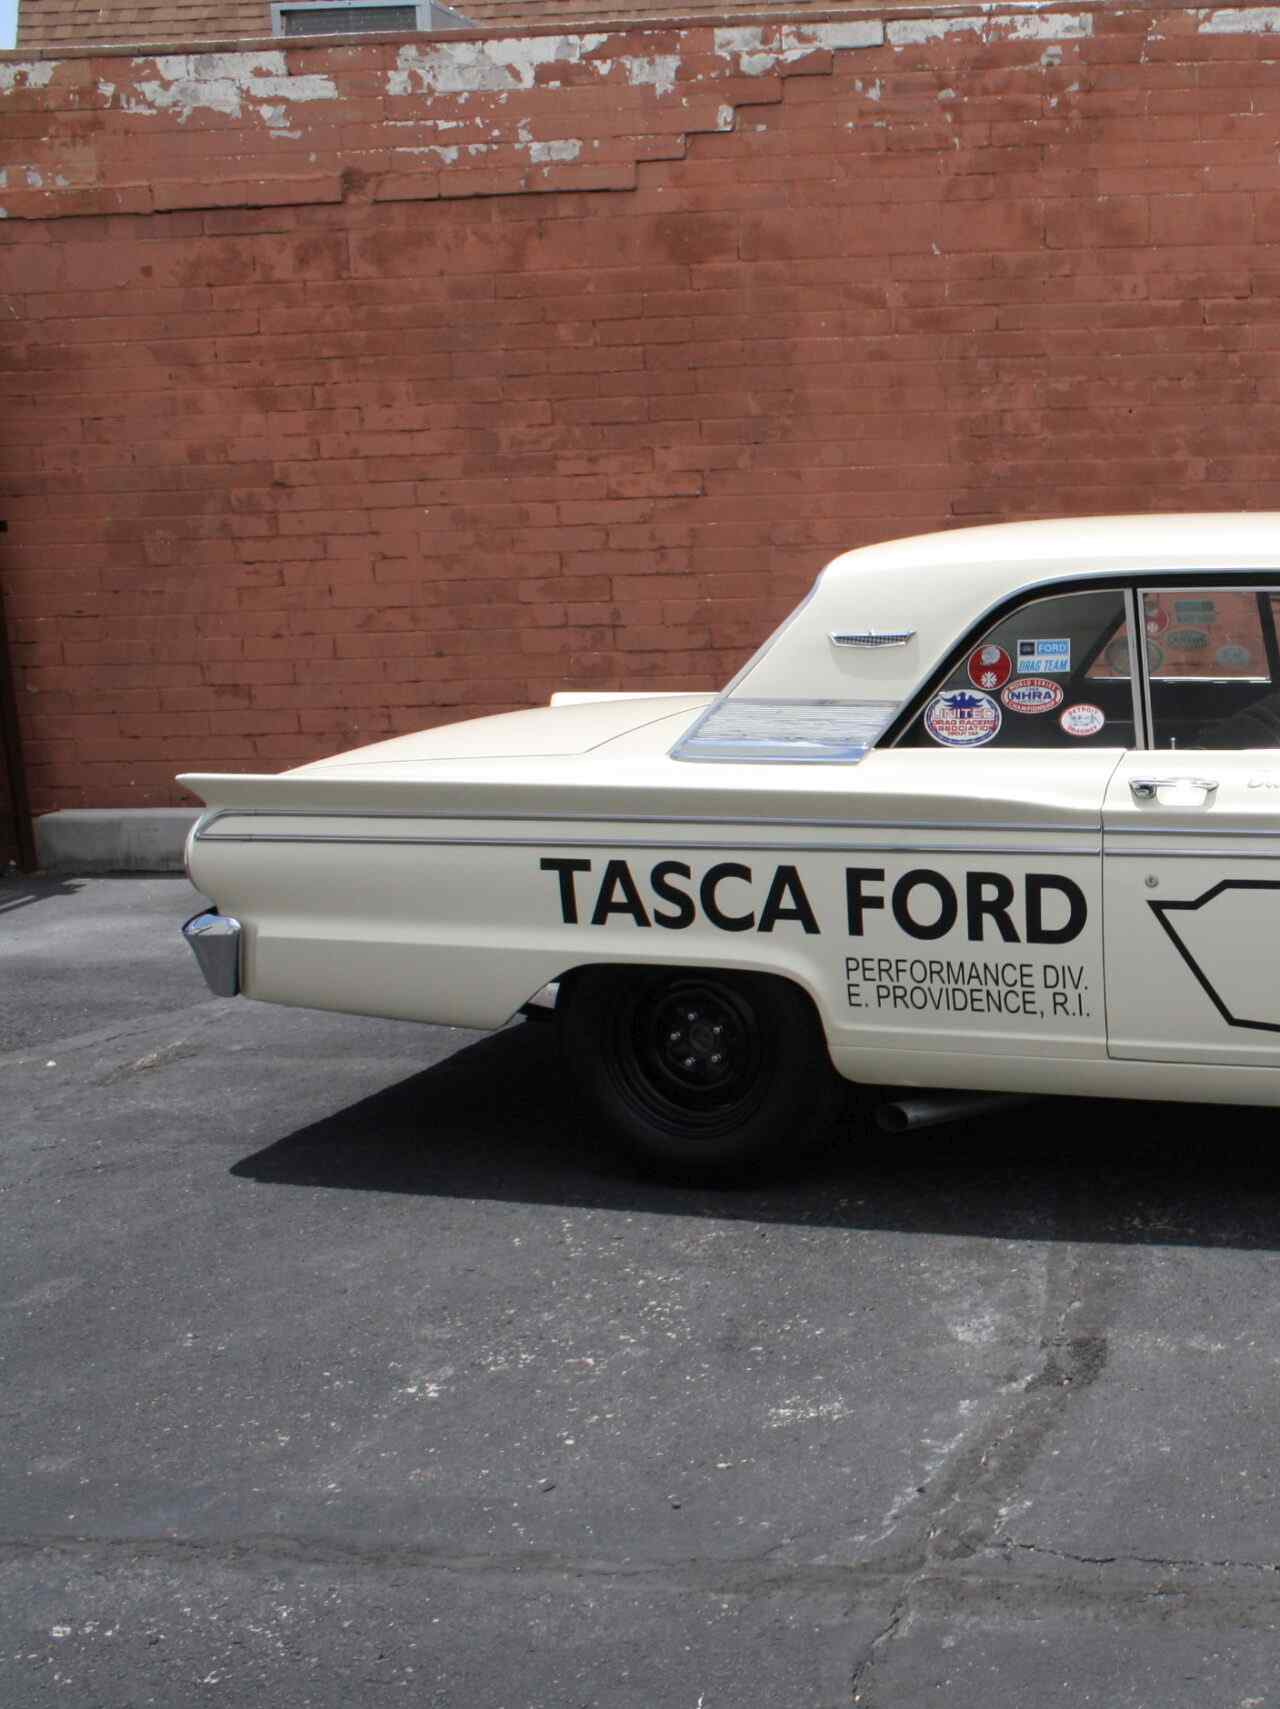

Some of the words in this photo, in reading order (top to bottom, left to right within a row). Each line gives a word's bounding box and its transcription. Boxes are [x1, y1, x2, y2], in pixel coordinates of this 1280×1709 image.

[1038, 643, 1067, 653] FORD
[1043, 659, 1068, 671] TEAM
[1010, 691, 1053, 700] NHRA
[932, 707, 994, 719] UNITED
[540, 857, 821, 935] TASCA
[845, 867, 1088, 945] FORD
[845, 957, 1035, 988] PERFORMANCE
[1043, 964, 1089, 990] DIV.
[847, 983, 869, 1007] E.
[876, 984, 1045, 1018] PROVIDENCE,
[1053, 992, 1091, 1017] R.I.
